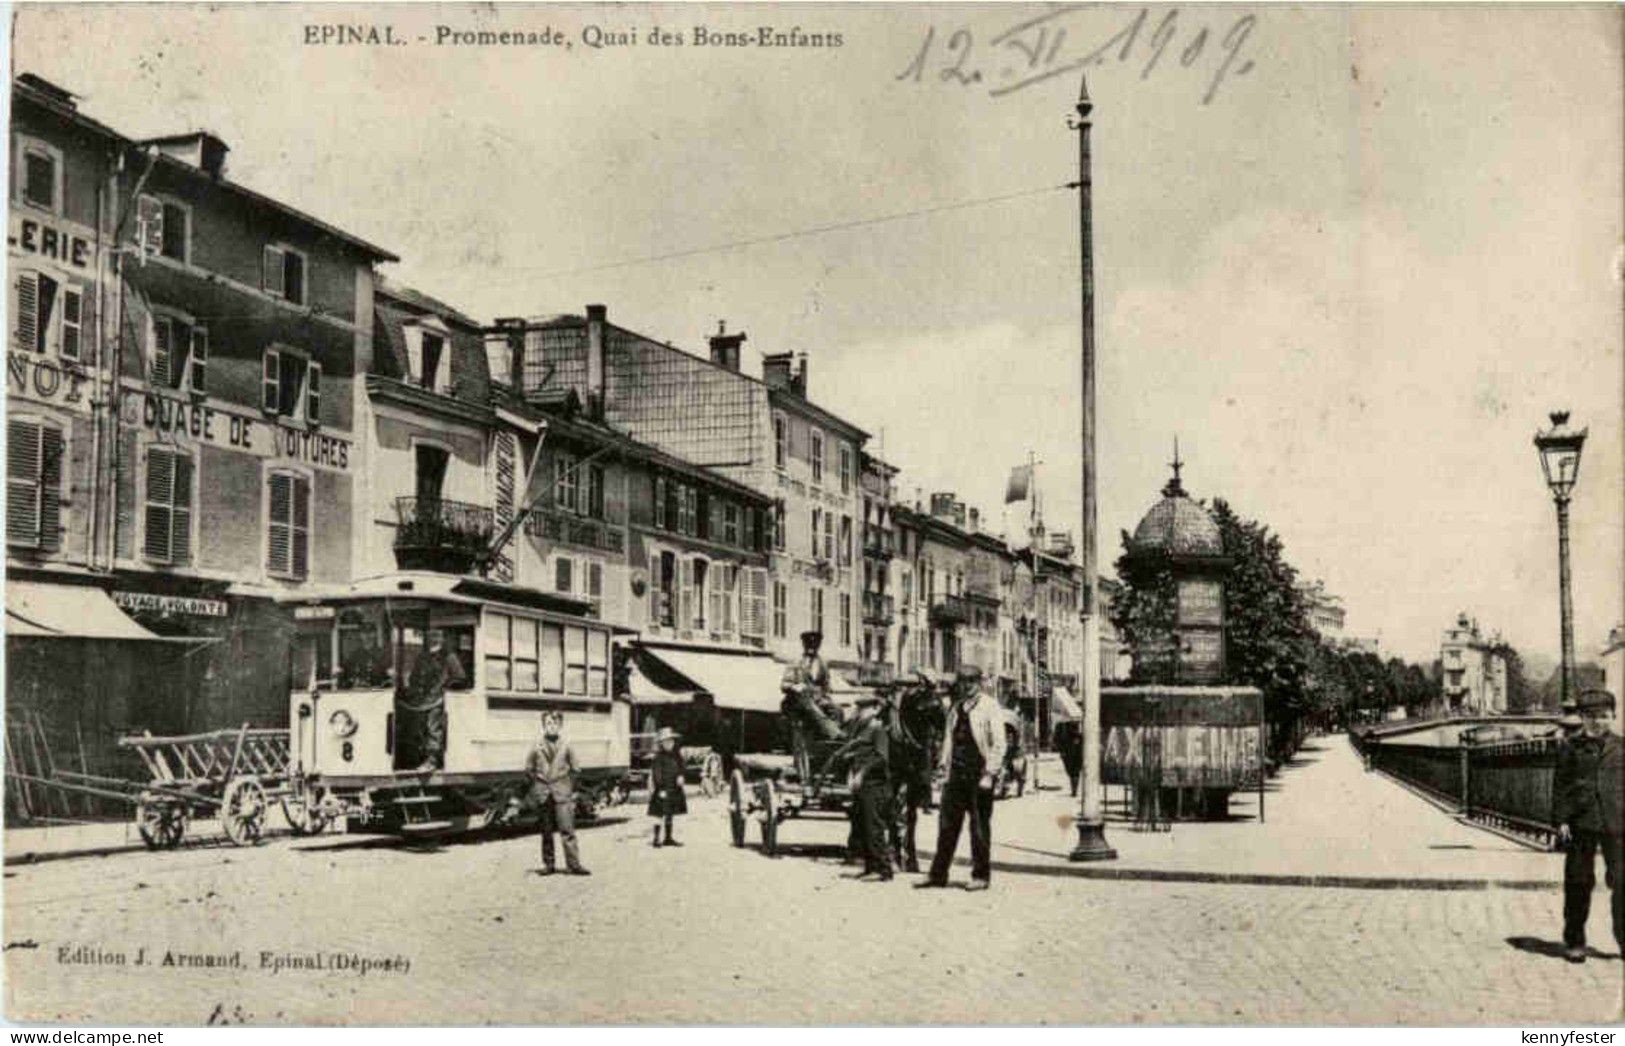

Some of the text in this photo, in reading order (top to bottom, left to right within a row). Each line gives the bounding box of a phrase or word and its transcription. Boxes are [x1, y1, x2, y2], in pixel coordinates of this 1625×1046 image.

[143, 390, 215, 440] OUAGE
[229, 415, 251, 448] DE
[342, 741, 354, 763] 8
